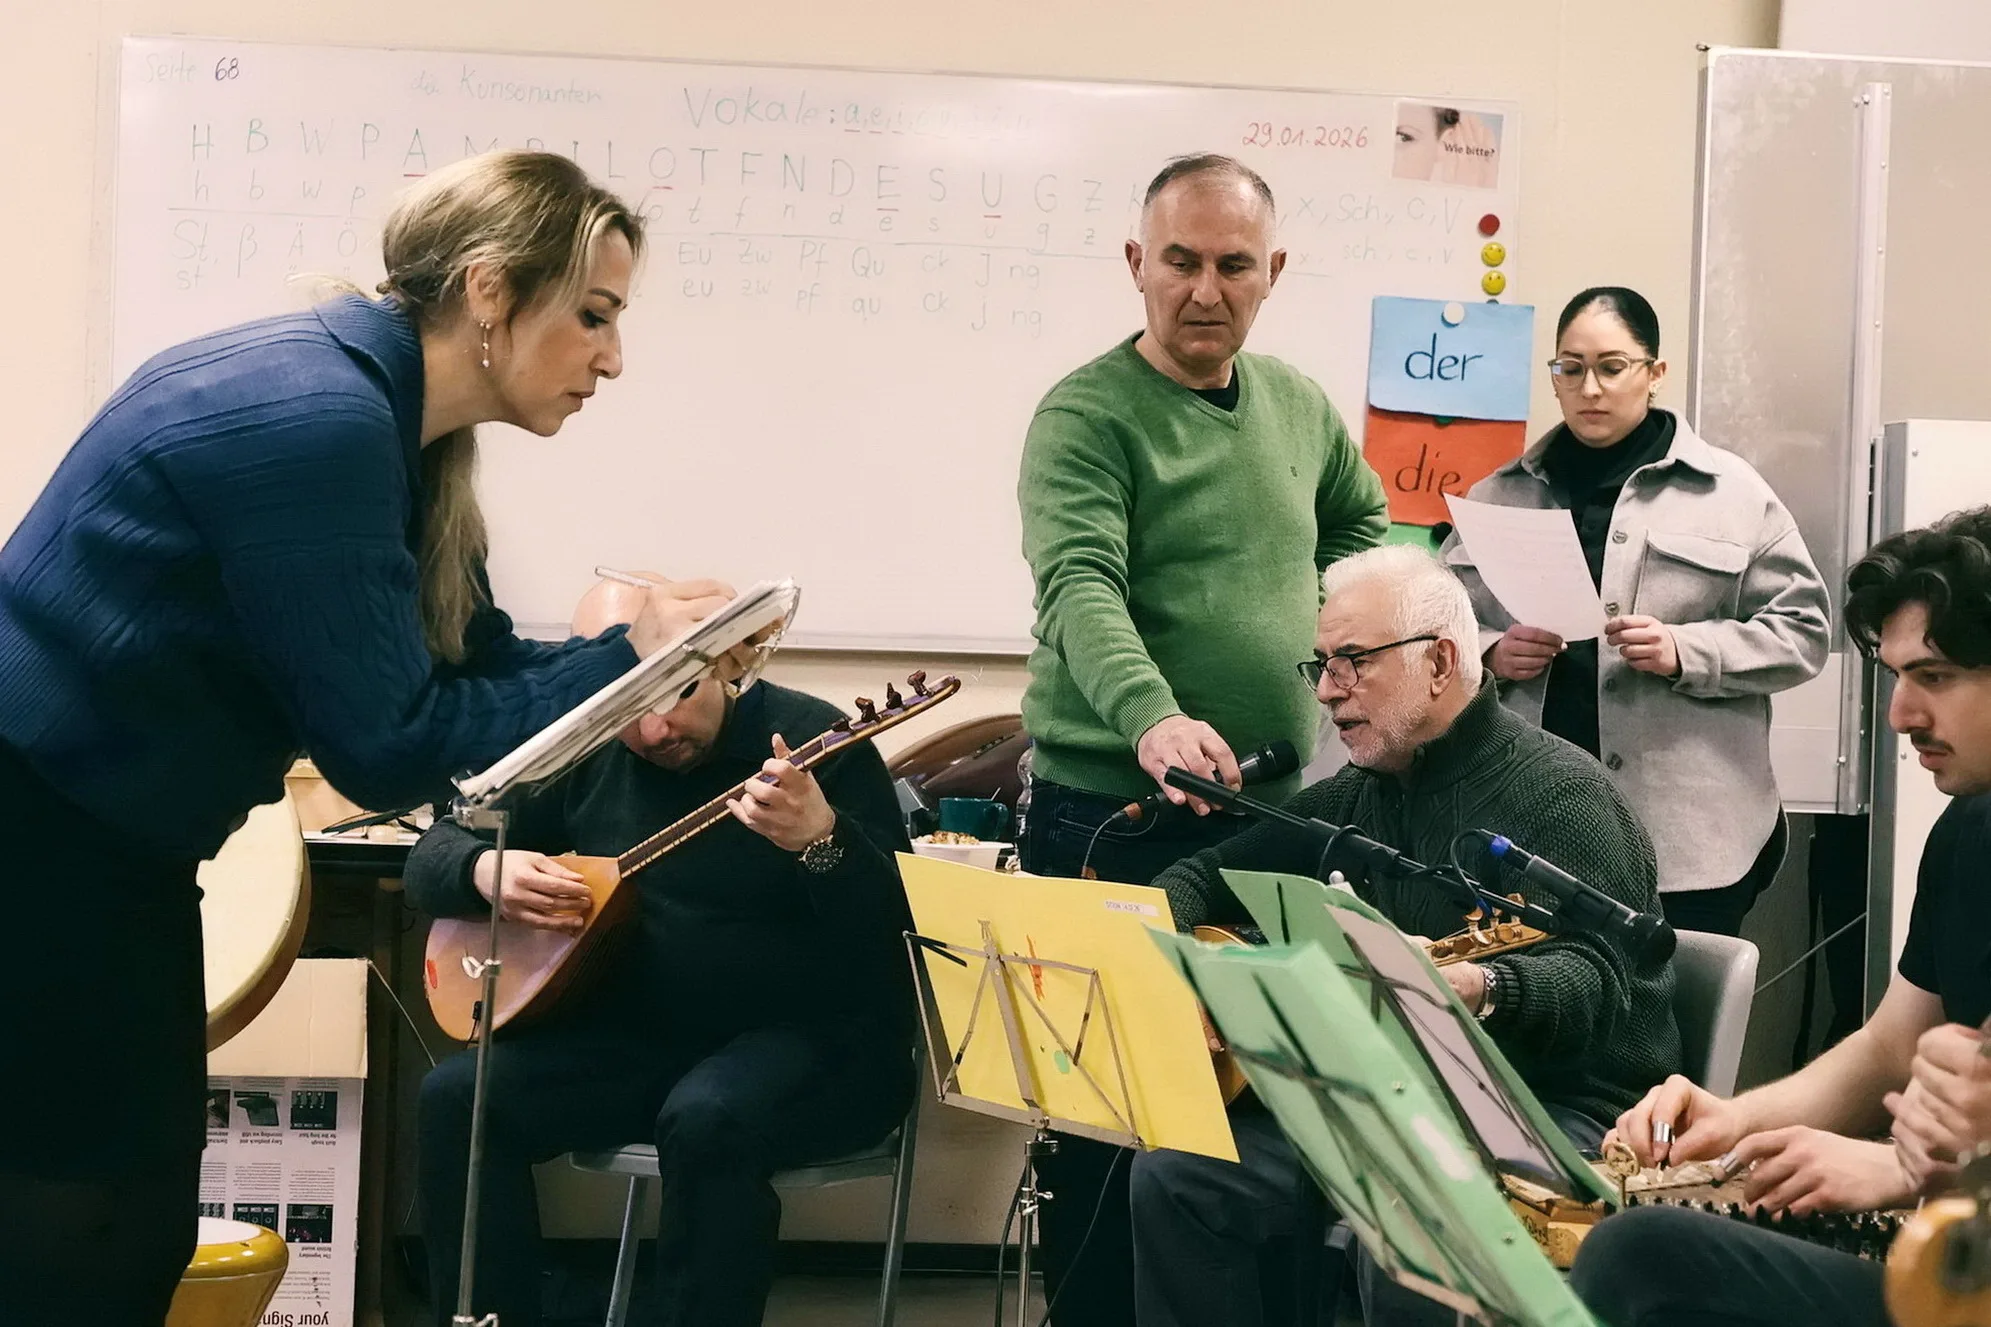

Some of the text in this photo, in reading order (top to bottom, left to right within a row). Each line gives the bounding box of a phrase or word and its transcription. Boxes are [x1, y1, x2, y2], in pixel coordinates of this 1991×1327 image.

[215, 56, 240, 81] 68
[1241, 120, 1369, 150] 29.01.2026
[1444, 142, 1495, 157] Wie bitte?
[191, 124, 215, 161] H
[246, 118, 269, 155] B
[300, 119, 333, 156] W
[361, 122, 380, 160] P
[403, 128, 428, 168] A
[608, 140, 627, 180] L
[689, 147, 719, 185] T
[740, 151, 764, 187] F
[782, 152, 807, 192] N
[828, 158, 856, 197] D
[877, 164, 901, 199] E
[981, 171, 1002, 209] U
[1034, 173, 1059, 213] G
[1404, 332, 1484, 381] der
[1395, 443, 1463, 498] die
[259, 1310, 329, 1327] your Sign
